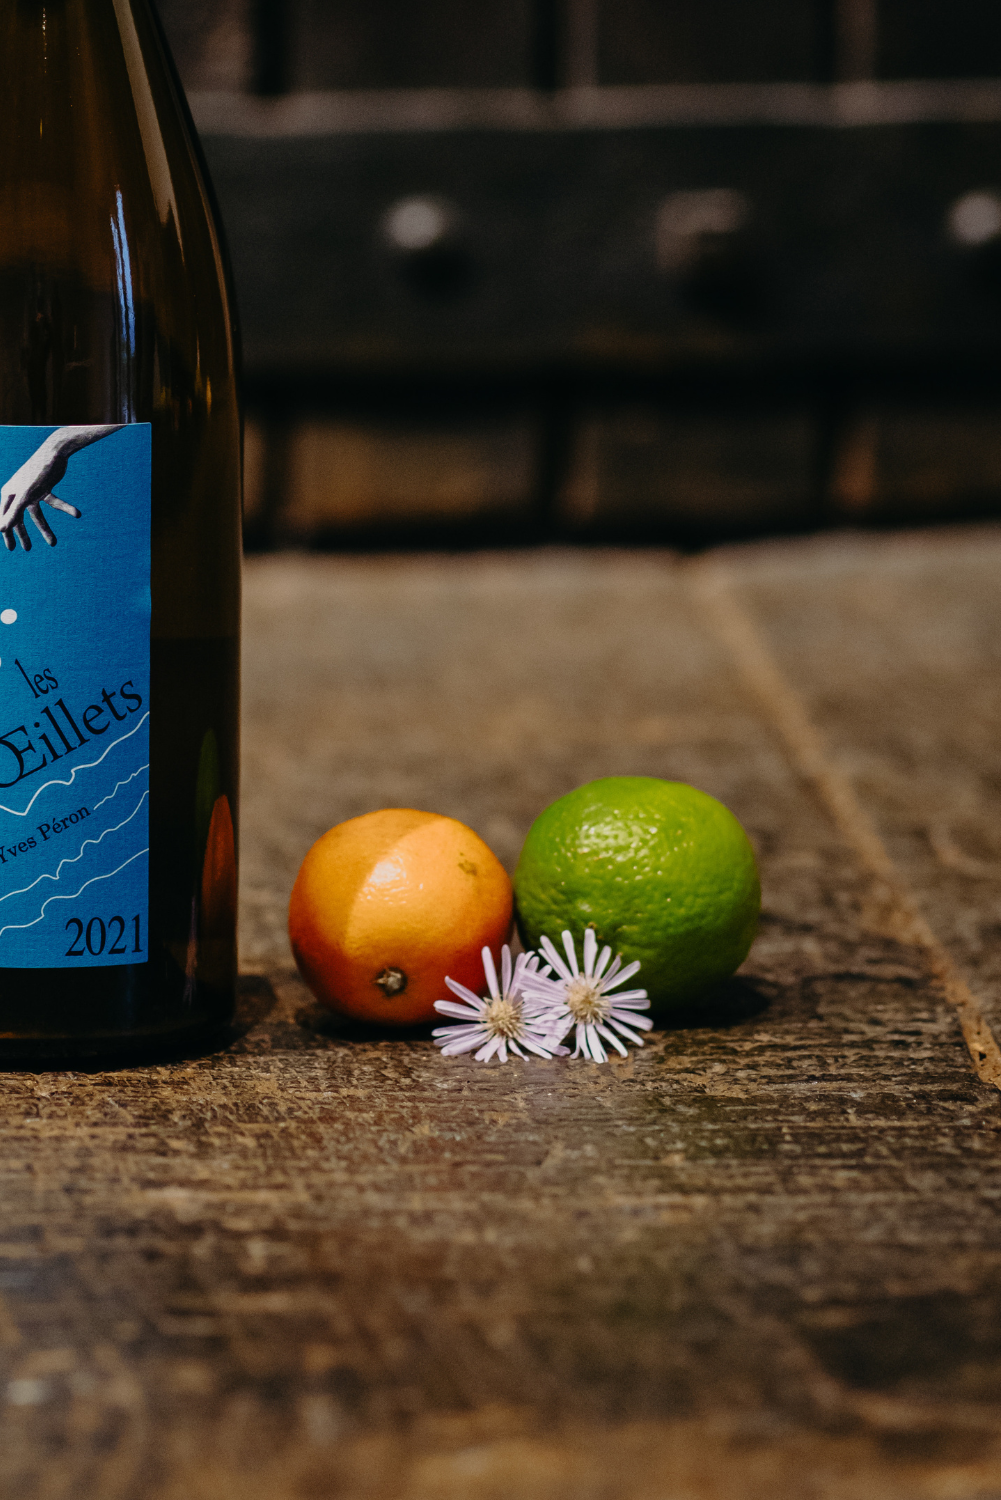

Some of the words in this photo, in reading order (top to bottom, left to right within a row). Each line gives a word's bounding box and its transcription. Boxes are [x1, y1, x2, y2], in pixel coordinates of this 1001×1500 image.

[14, 658, 59, 699] les
[36, 806, 91, 842] Péron
[64, 913, 144, 957] 2021
